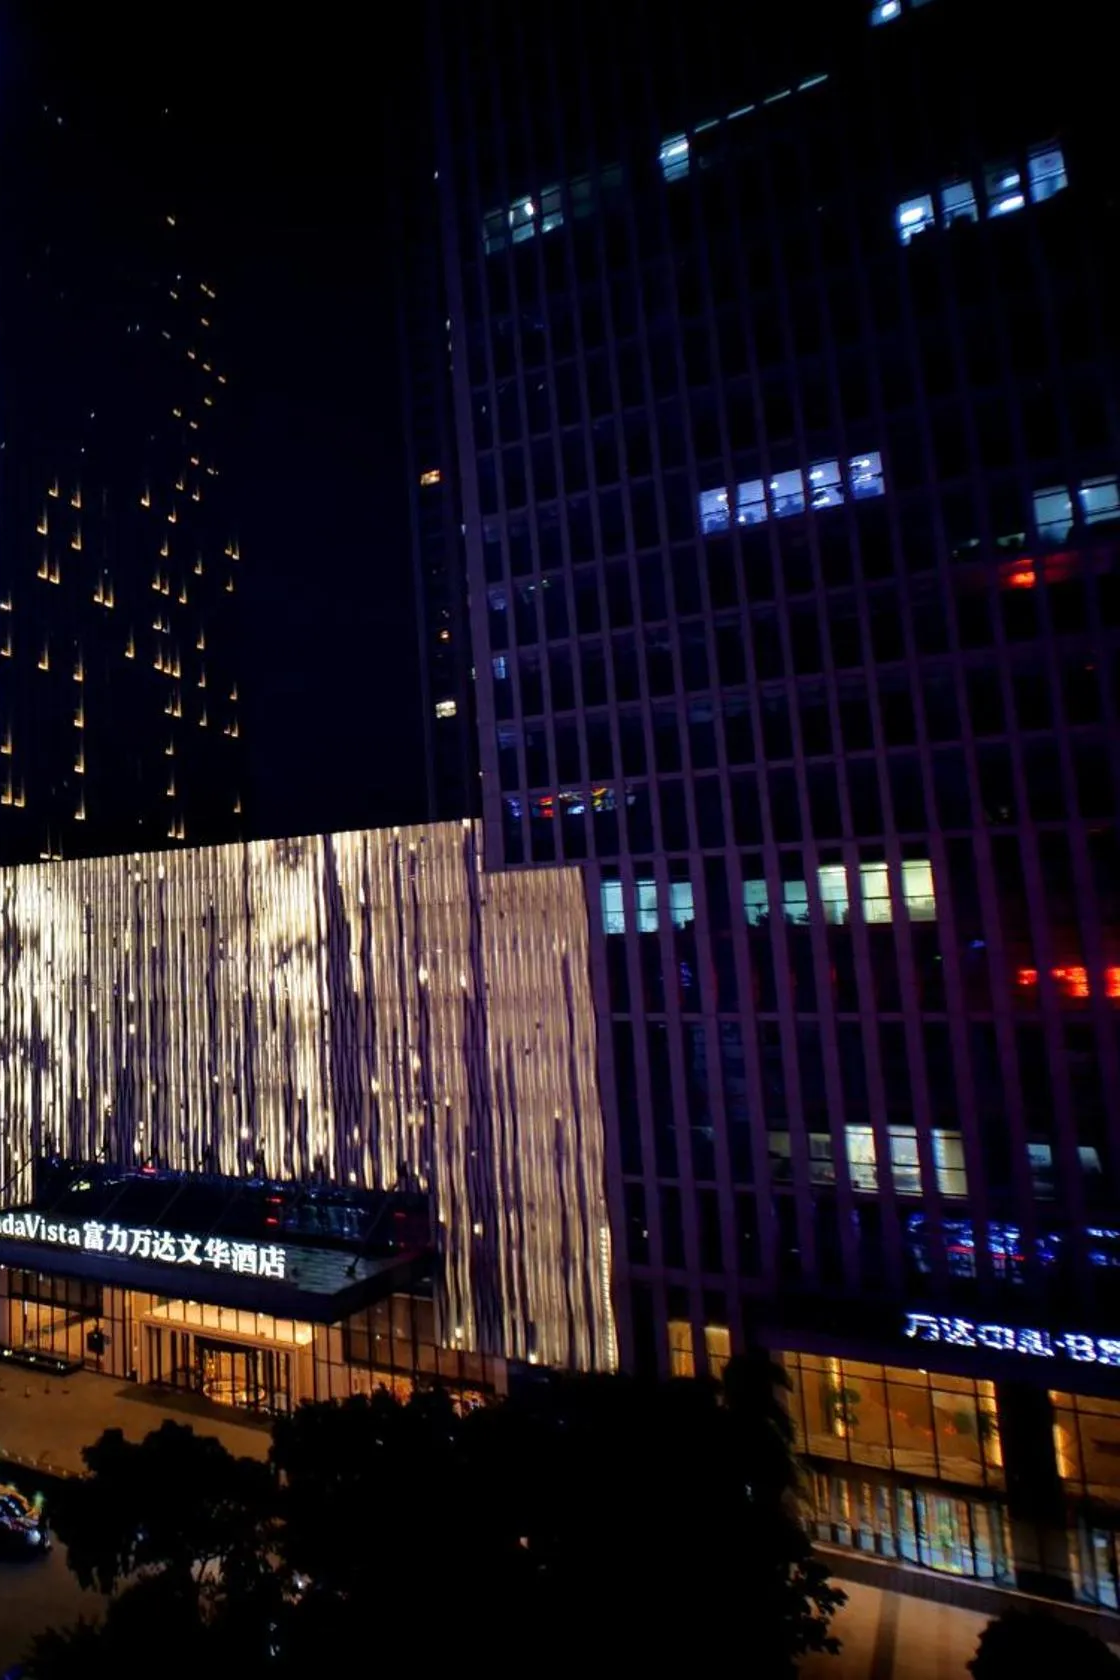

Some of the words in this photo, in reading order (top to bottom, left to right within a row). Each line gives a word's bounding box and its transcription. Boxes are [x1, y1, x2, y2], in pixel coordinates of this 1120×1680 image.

[82, 1220, 286, 1279] 富力万达文华酒店
